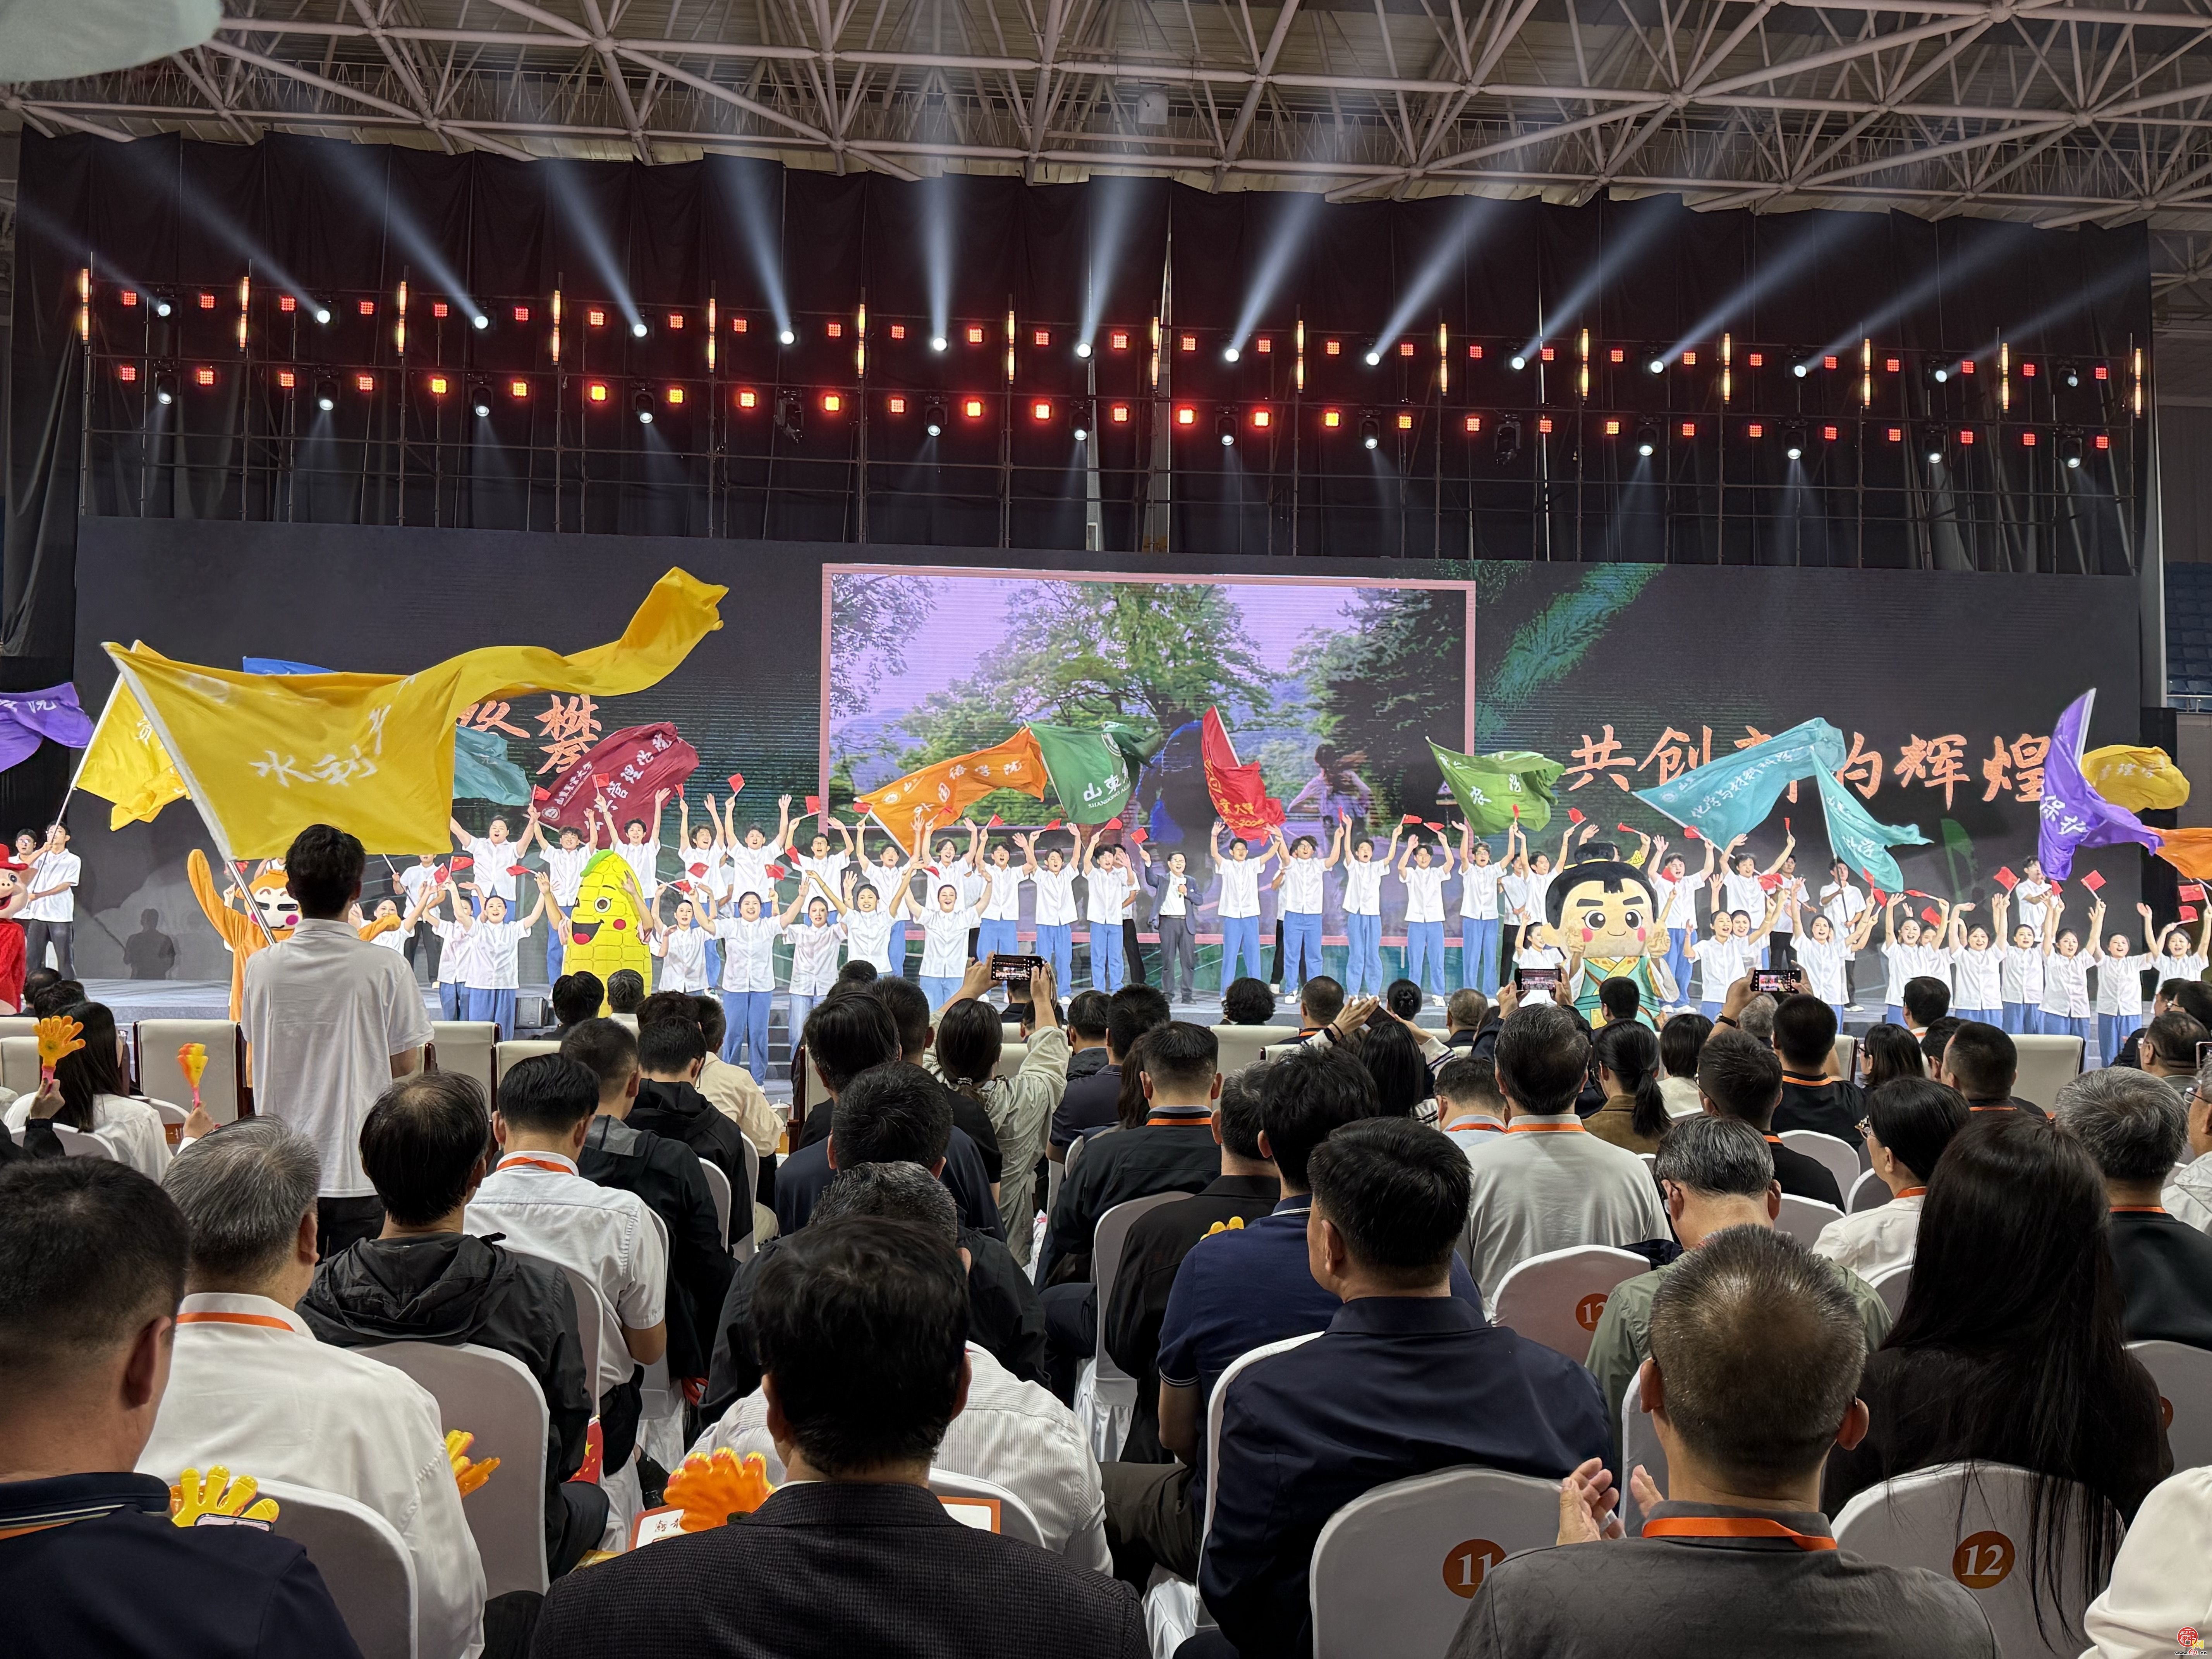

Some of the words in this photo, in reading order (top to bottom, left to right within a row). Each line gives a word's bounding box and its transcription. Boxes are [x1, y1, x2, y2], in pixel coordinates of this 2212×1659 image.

[1088, 791, 1120, 809] SHANDONG
[1457, 1553, 1492, 1585] 11
[1961, 1544, 2004, 1576] 12
